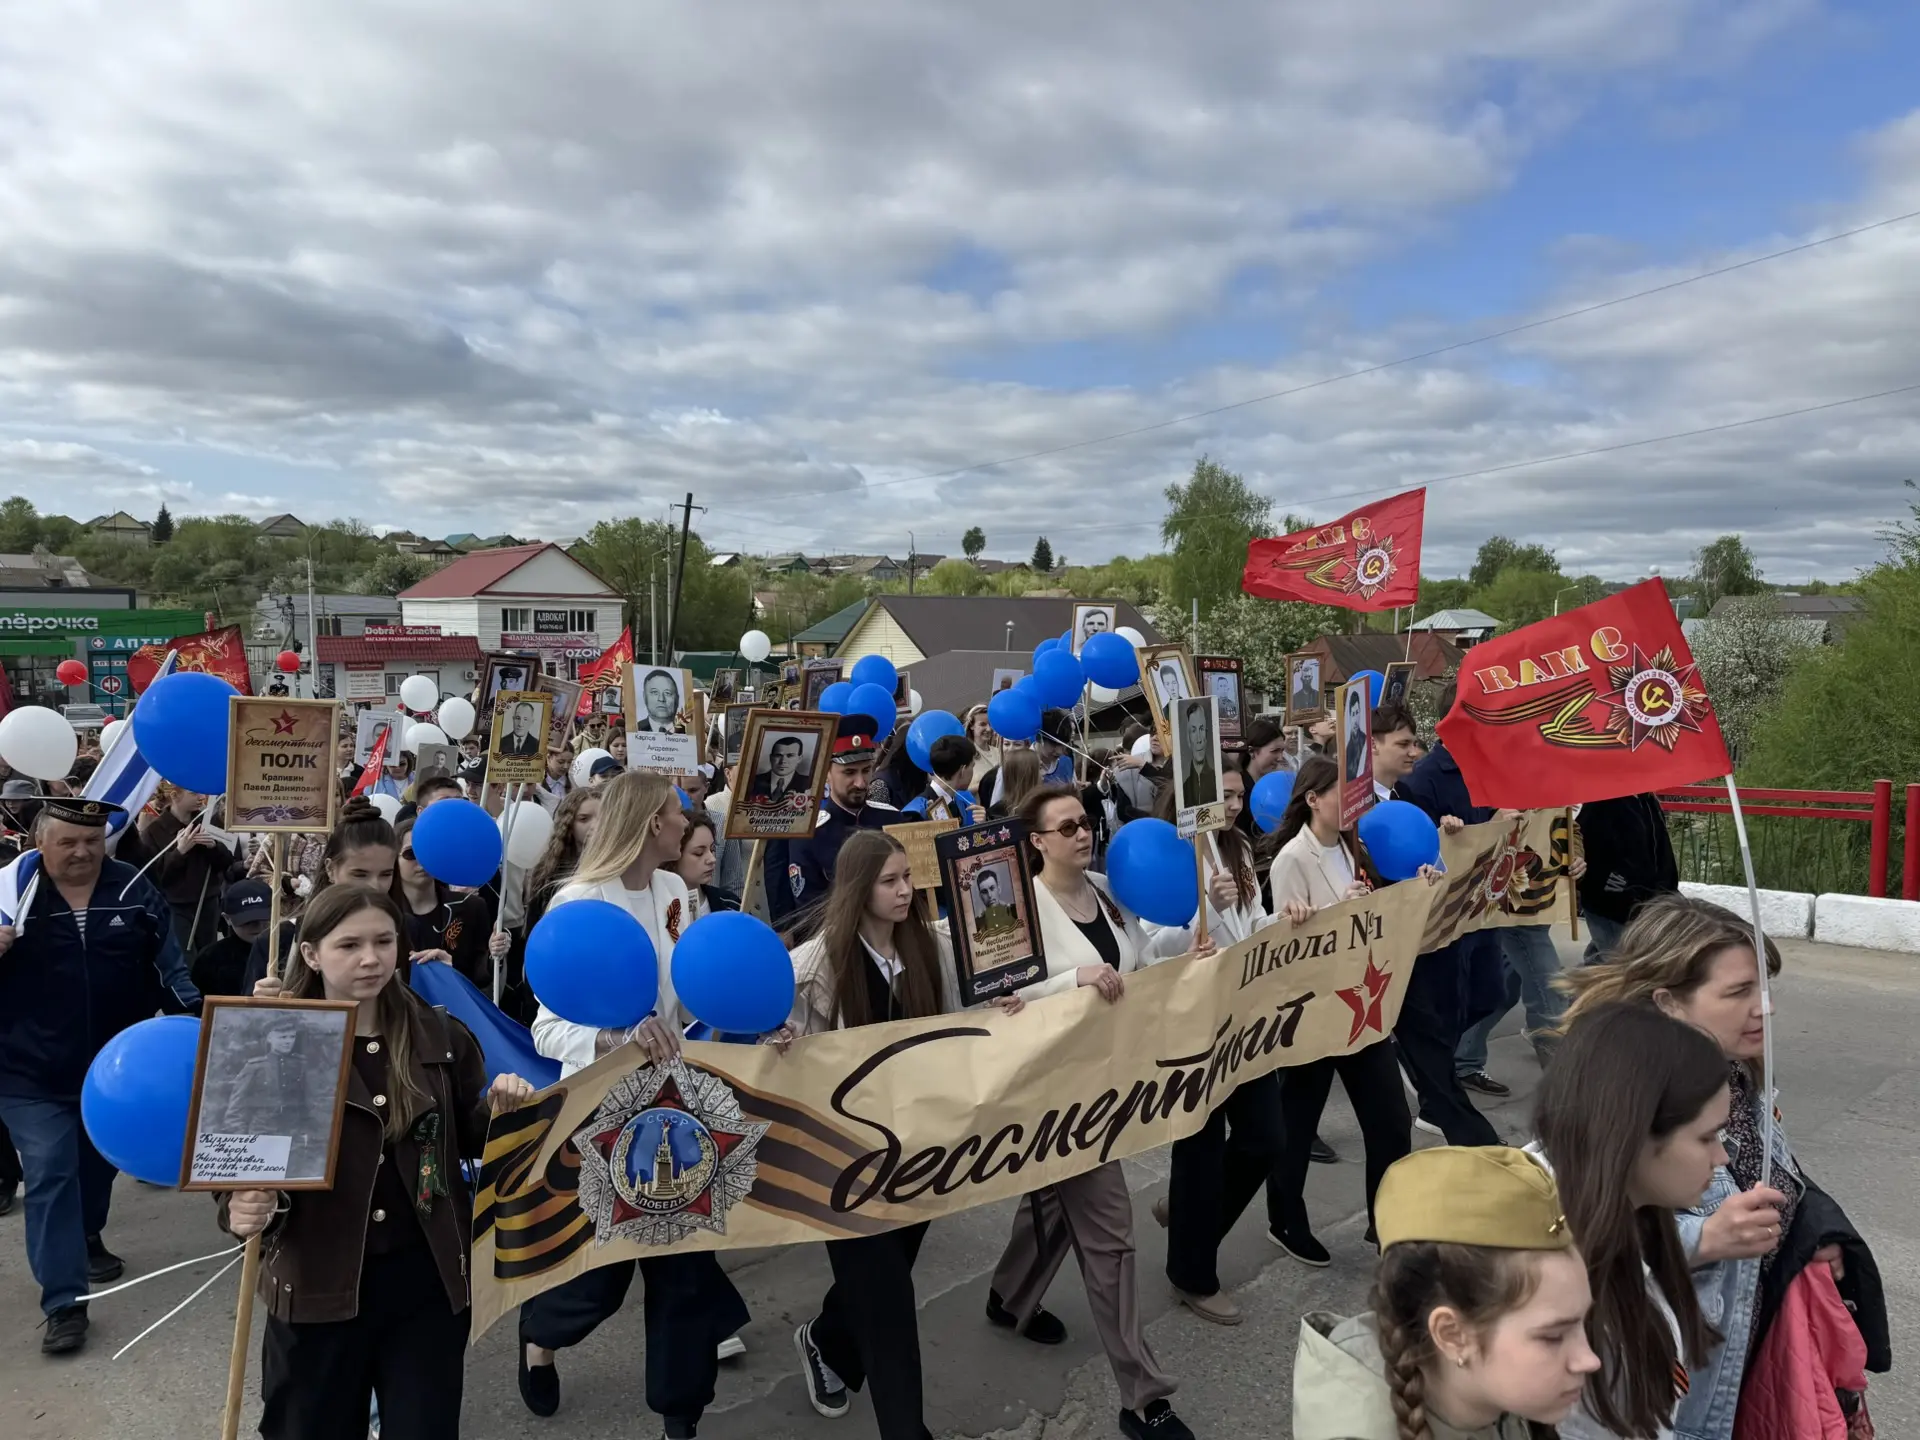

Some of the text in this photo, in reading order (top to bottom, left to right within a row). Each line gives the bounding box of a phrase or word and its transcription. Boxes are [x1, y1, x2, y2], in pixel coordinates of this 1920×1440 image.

[536, 612, 566, 622] АДВОКАТ
[565, 649, 601, 658] OZON
[635, 734, 656, 742] Карпов
[647, 744, 679, 752] Андреевич
[261, 753, 317, 769] ПОЛК
[262, 773, 304, 782] Крапивин
[243, 783, 322, 793] Павел Данилович
[749, 817, 795, 825] Филиппович
[241, 896, 263, 906] FILA
[975, 948, 997, 958] Михаил
[1238, 910, 1384, 990] Школа №1
[646, 1113, 689, 1126] СССР
[638, 1197, 686, 1210] ПОБЕДА
